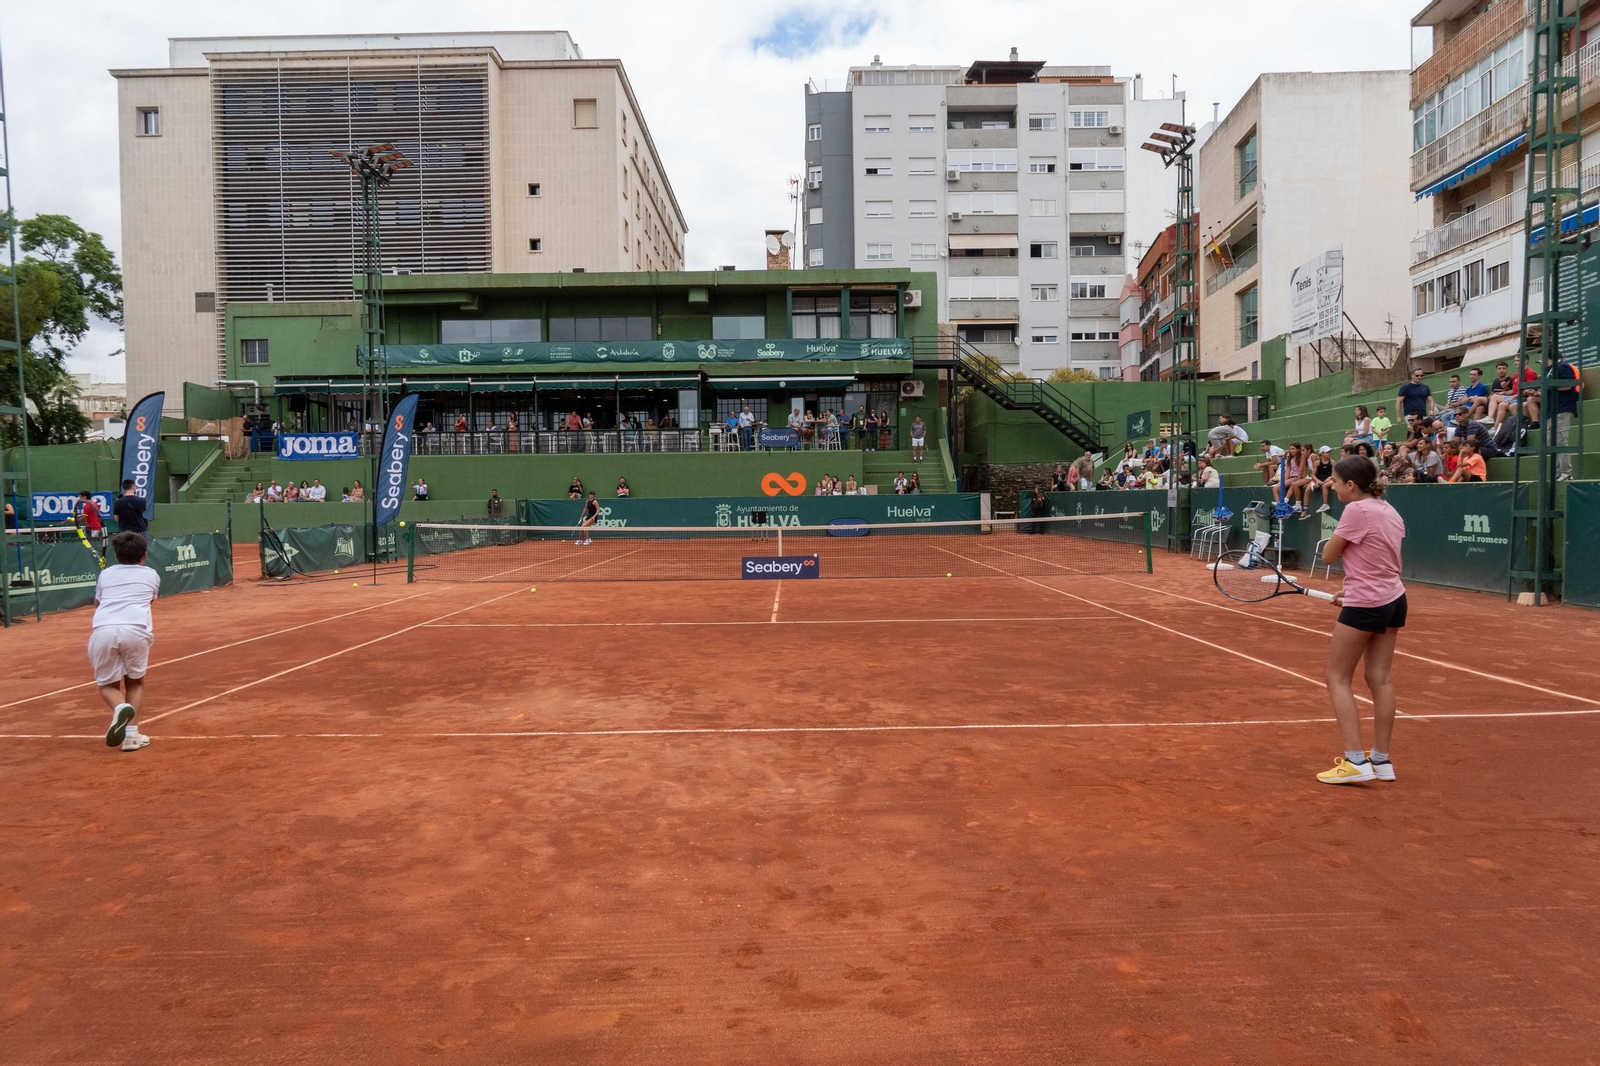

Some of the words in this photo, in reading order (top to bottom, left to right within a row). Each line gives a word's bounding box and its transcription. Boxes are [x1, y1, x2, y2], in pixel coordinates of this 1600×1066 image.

[1296, 276, 1312, 292] Tenis
[757, 348, 785, 358] Seabery
[806, 344, 836, 353] Huelva
[871, 348, 903, 356] HUELVA
[761, 433, 790, 442] Seabery
[132, 433, 155, 499] eabery
[381, 432, 408, 509] Seabery
[736, 505, 787, 514] Ayuntamiento
[789, 504, 798, 512] de
[887, 505, 931, 517] Huelva
[1448, 533, 1475, 543] miguel
[1476, 536, 1508, 544] romero
[165, 563, 186, 572] miguel
[187, 560, 209, 569] romero
[746, 560, 803, 575] Seabery
[53, 572, 97, 584] Información
